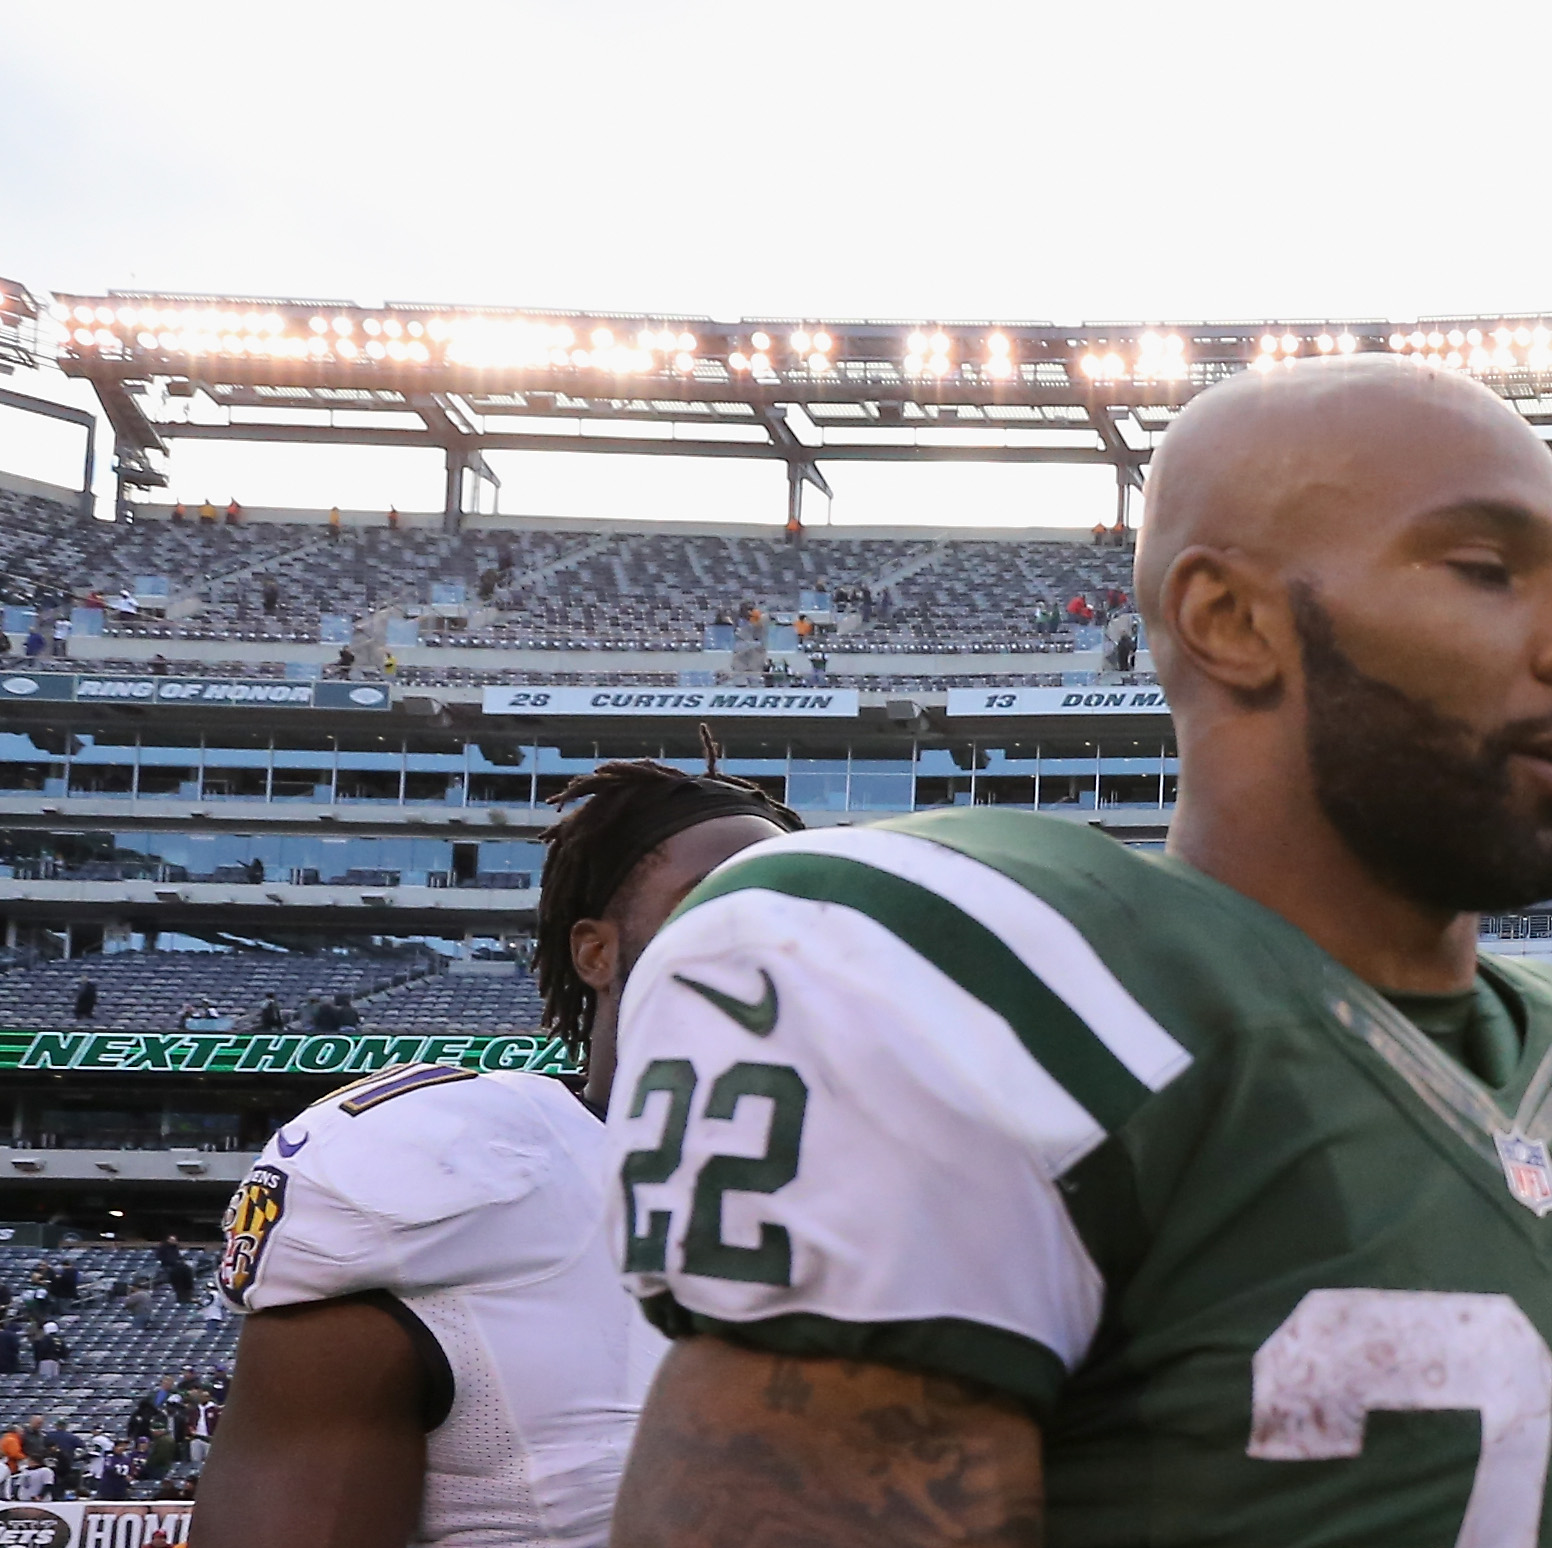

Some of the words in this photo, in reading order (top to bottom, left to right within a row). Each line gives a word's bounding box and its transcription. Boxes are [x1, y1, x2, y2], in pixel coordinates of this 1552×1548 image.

[76, 680, 154, 698] RING
[159, 682, 203, 700] OF
[203, 684, 313, 703] HONOR
[507, 692, 551, 708] 28
[590, 693, 704, 709] CURTIS
[708, 694, 834, 710] MARTIN
[984, 693, 1017, 709] 13
[1061, 693, 1127, 708] DON
[17, 1031, 237, 1071] NEXT
[233, 1035, 475, 1073] HOME
[620, 1057, 809, 1288] 22
